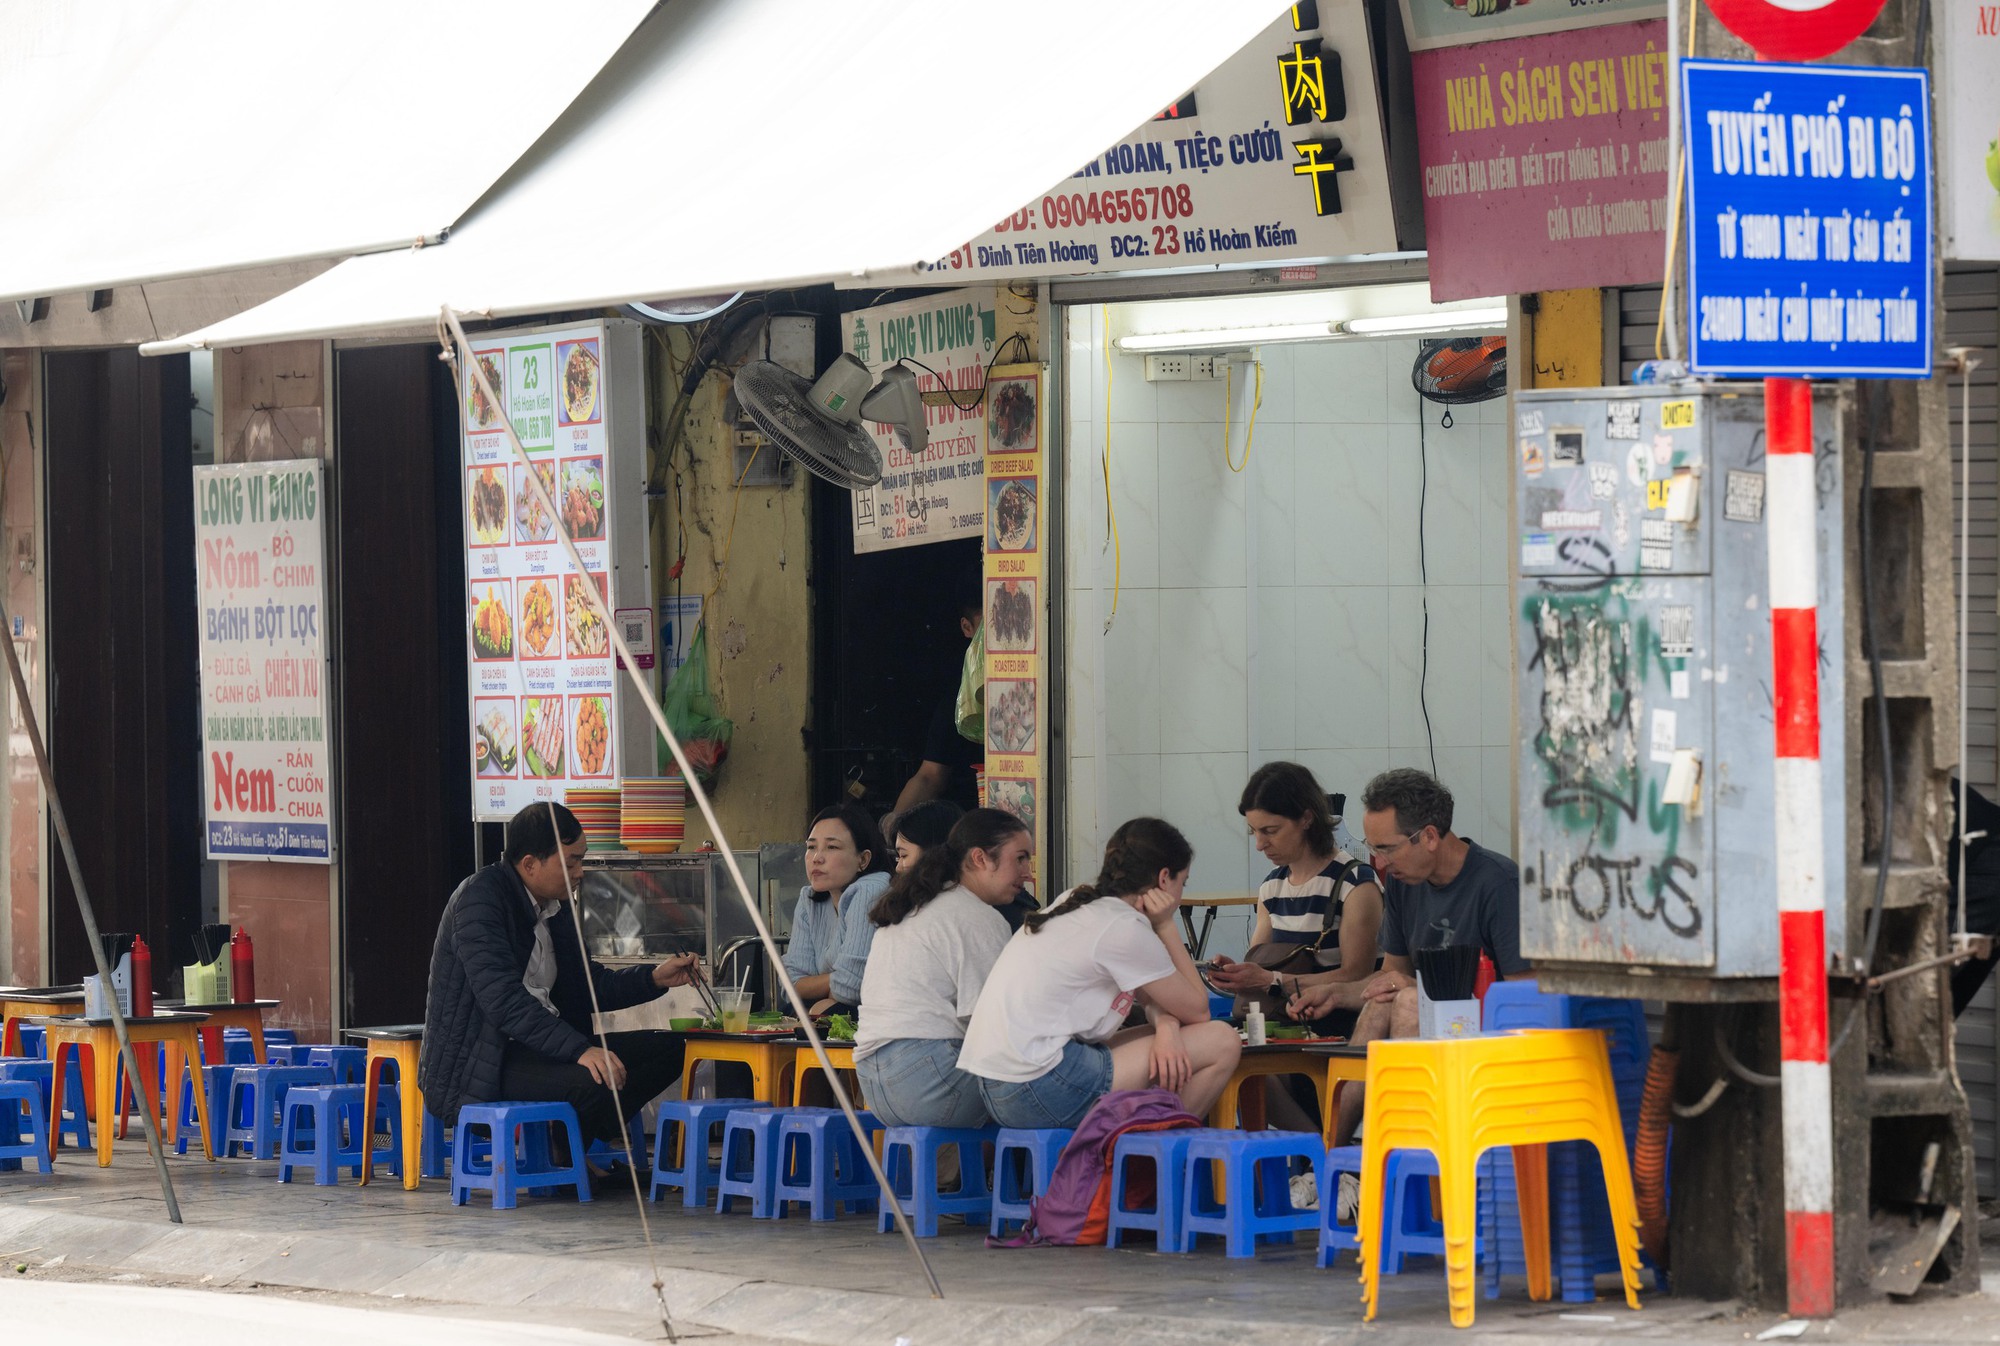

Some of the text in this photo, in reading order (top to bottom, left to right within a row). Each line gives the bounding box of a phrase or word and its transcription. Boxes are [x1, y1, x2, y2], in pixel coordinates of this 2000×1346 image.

[1279, 4, 1335, 216] 肉干
[1446, 63, 1496, 132] NHÀ
[1500, 58, 1564, 126] SÁCH
[1568, 58, 1618, 117] SEN
[1105, 141, 1173, 175] HOAN,
[1174, 130, 1224, 174] TIỆC
[1229, 120, 1284, 165] CƯỚI
[1707, 91, 1916, 197] TUYẾN PHỐ ĐI BỘ
[1425, 150, 1468, 198] CHUYỂN
[1468, 161, 1489, 199] ĐỊA
[1488, 145, 1518, 190] ĐIỂM
[1521, 143, 1545, 187] ĐẾN
[1545, 151, 1566, 183] 777
[1600, 138, 1617, 177] HÀ
[1042, 183, 1194, 229] 0904656708
[1547, 195, 1571, 241] CỬA
[1571, 192, 1602, 239] KHẨU
[1603, 198, 1649, 236] CHƯƠNG
[977, 245, 1013, 268] Đinh
[1014, 242, 1047, 265] Tiên
[1049, 239, 1099, 265] Hoàng
[1111, 221, 1298, 258] ĐC2: 23 Hồ Hoàn Kiếm
[880, 302, 975, 363] LONG VI DUNG
[523, 355, 539, 390] 23
[887, 447, 914, 469] GIA
[918, 426, 977, 463] TRUYỀN
[990, 458, 1034, 474] DRIED BEEF SALAD
[957, 460, 971, 480] TIỆC
[200, 470, 316, 527] LONG VI DUNG
[894, 494, 905, 515] 51
[895, 517, 907, 538] 23
[203, 530, 294, 600] Nộm BÒ
[273, 565, 315, 588] CHIM
[998, 559, 1026, 573] BIRD SALAD
[207, 597, 317, 647] BÁNH BỘT LỌC
[237, 651, 252, 676] GÀ
[265, 649, 319, 698] CHIÊN XÙ
[994, 660, 1029, 673] ROASTED BIRD
[215, 679, 262, 703] CÁNH GÀ
[211, 747, 313, 813] Nem RÁN
[287, 772, 324, 792] CUỐN
[288, 801, 324, 818] CHUA
[223, 825, 233, 847] 23
[279, 827, 288, 848] 51
